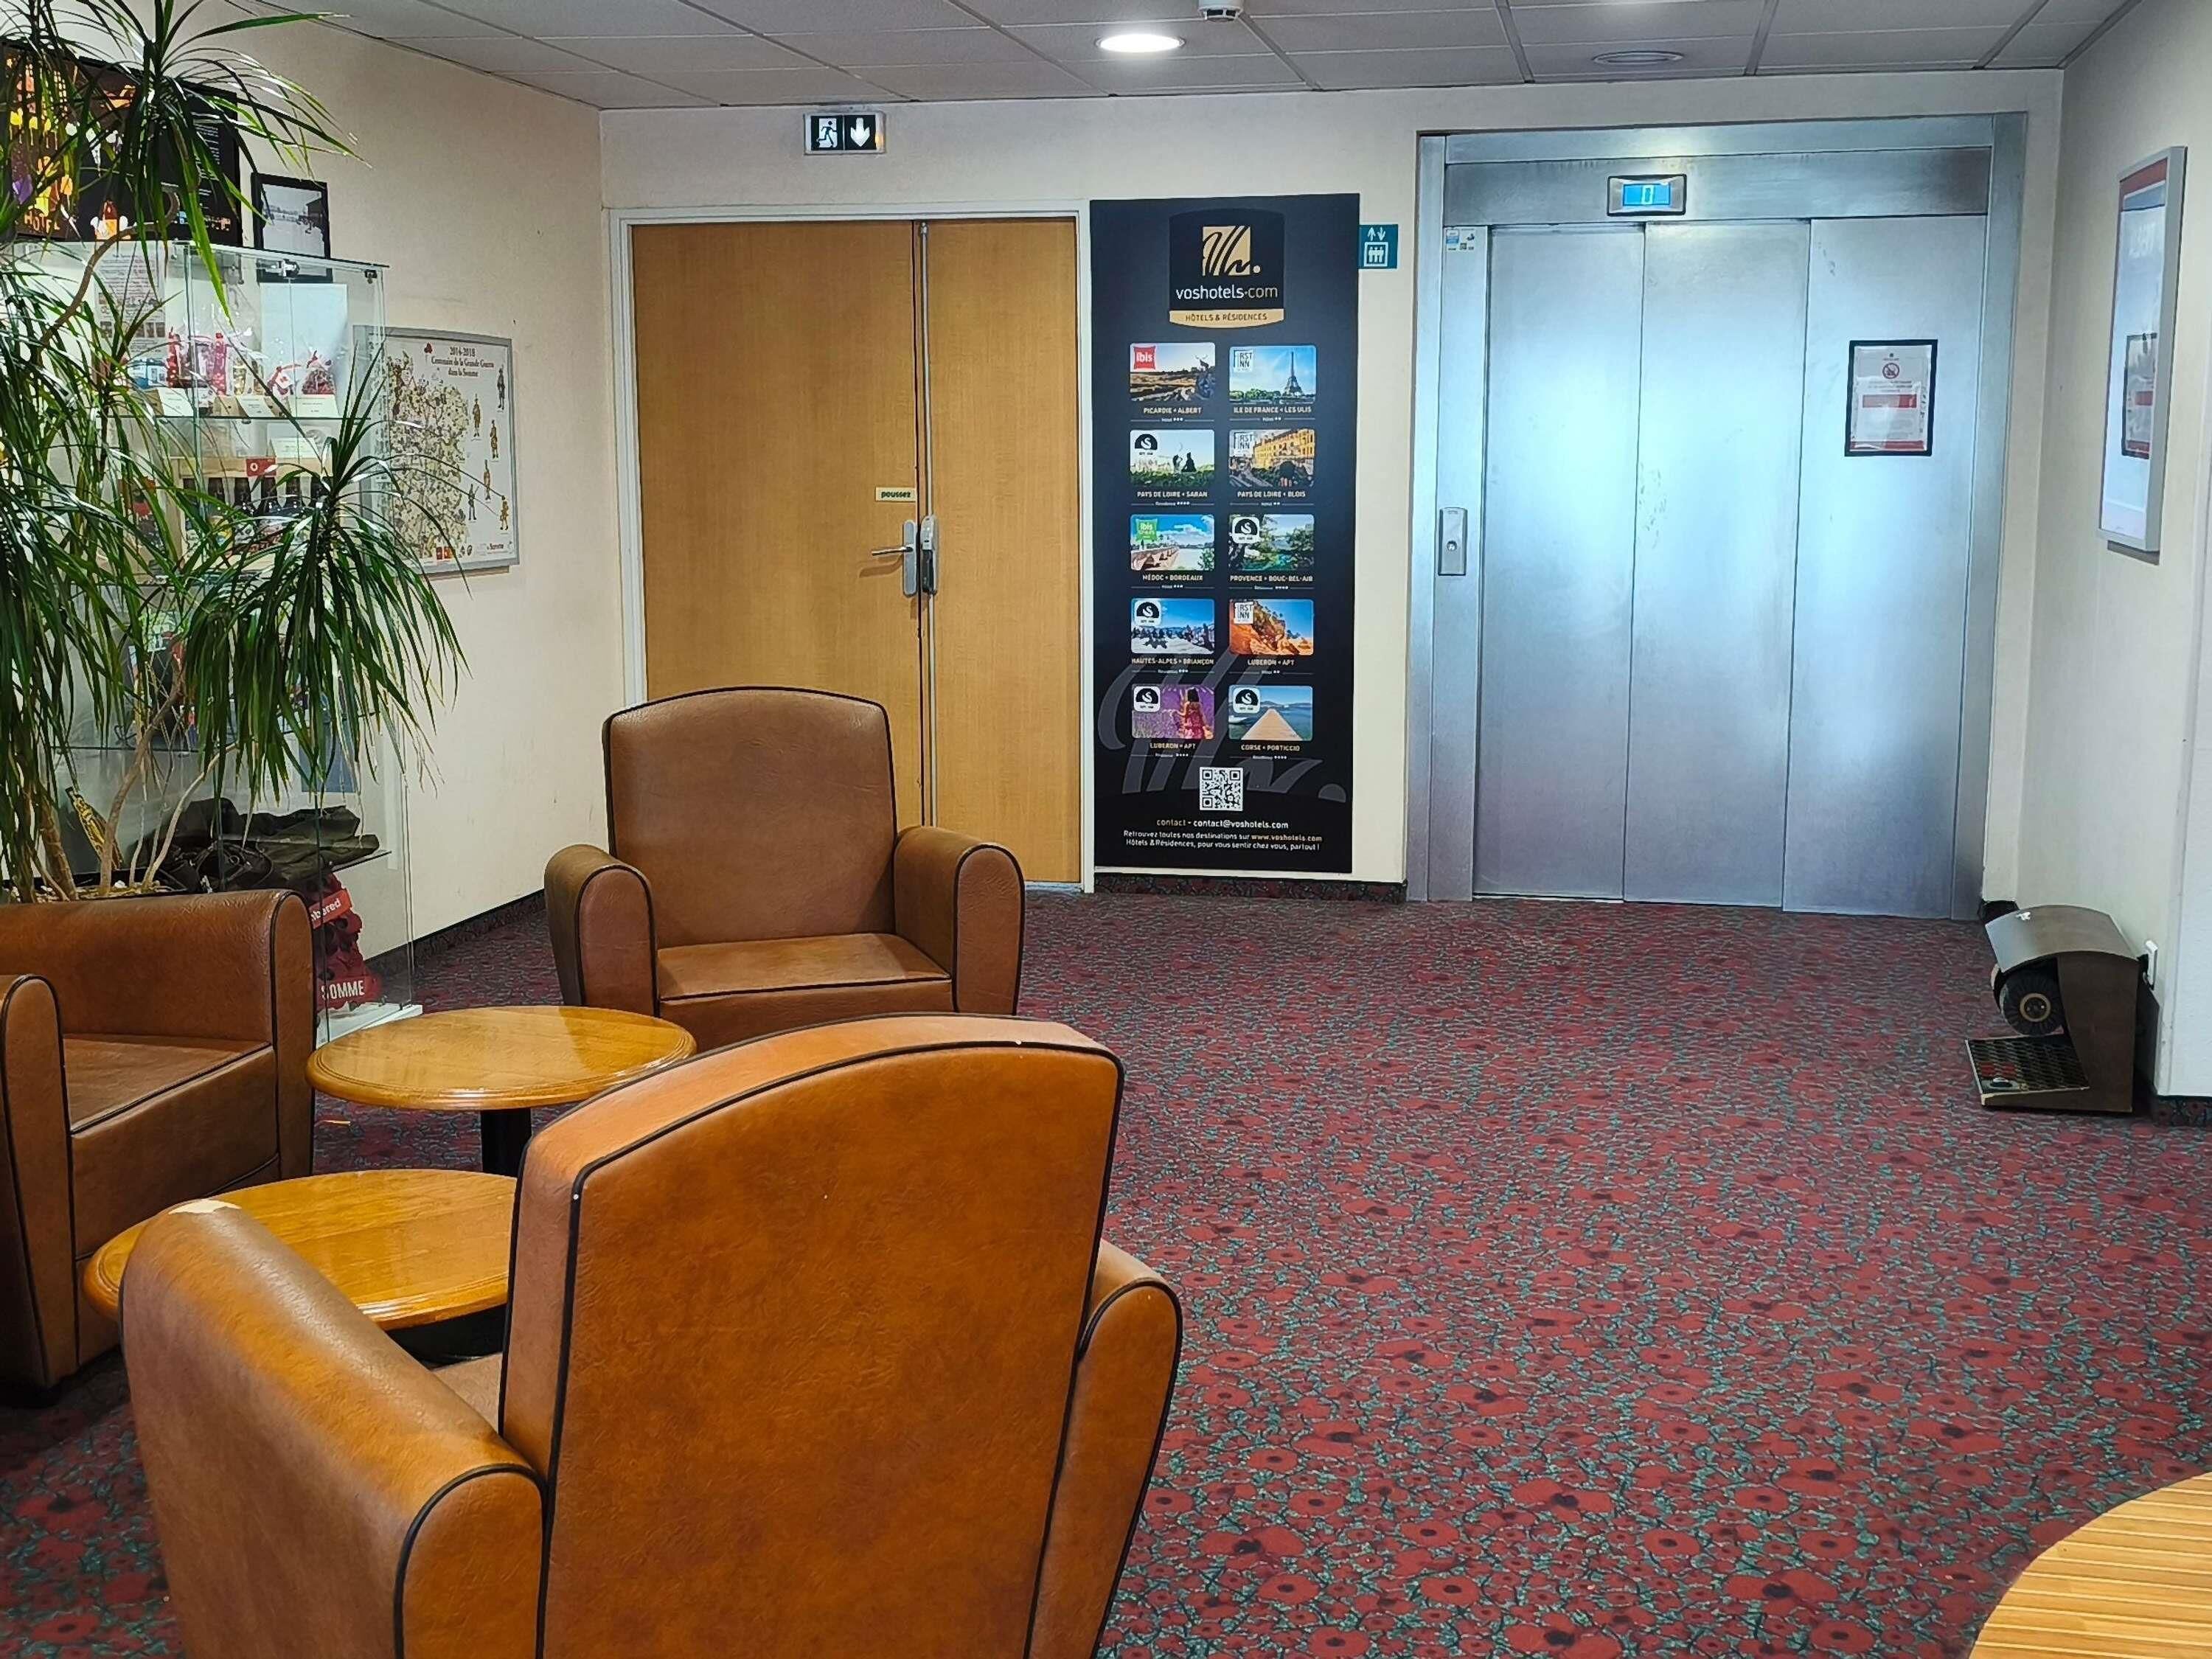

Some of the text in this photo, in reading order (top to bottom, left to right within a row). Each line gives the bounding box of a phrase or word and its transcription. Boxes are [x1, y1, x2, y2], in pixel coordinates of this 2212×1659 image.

[1641, 184, 1655, 204] 0
[1222, 313, 1267, 321] RÉSIDENCES
[450, 347, 475, 357] 2014-2018
[1136, 352, 1152, 362] ibis
[464, 358, 479, 366] Grande
[448, 367, 458, 376] dans
[463, 368, 479, 377] Somme
[1193, 819, 1289, 829] contact@voshotels.com
[1195, 832, 1237, 840] destinations
[321, 980, 365, 1000] SOMME
